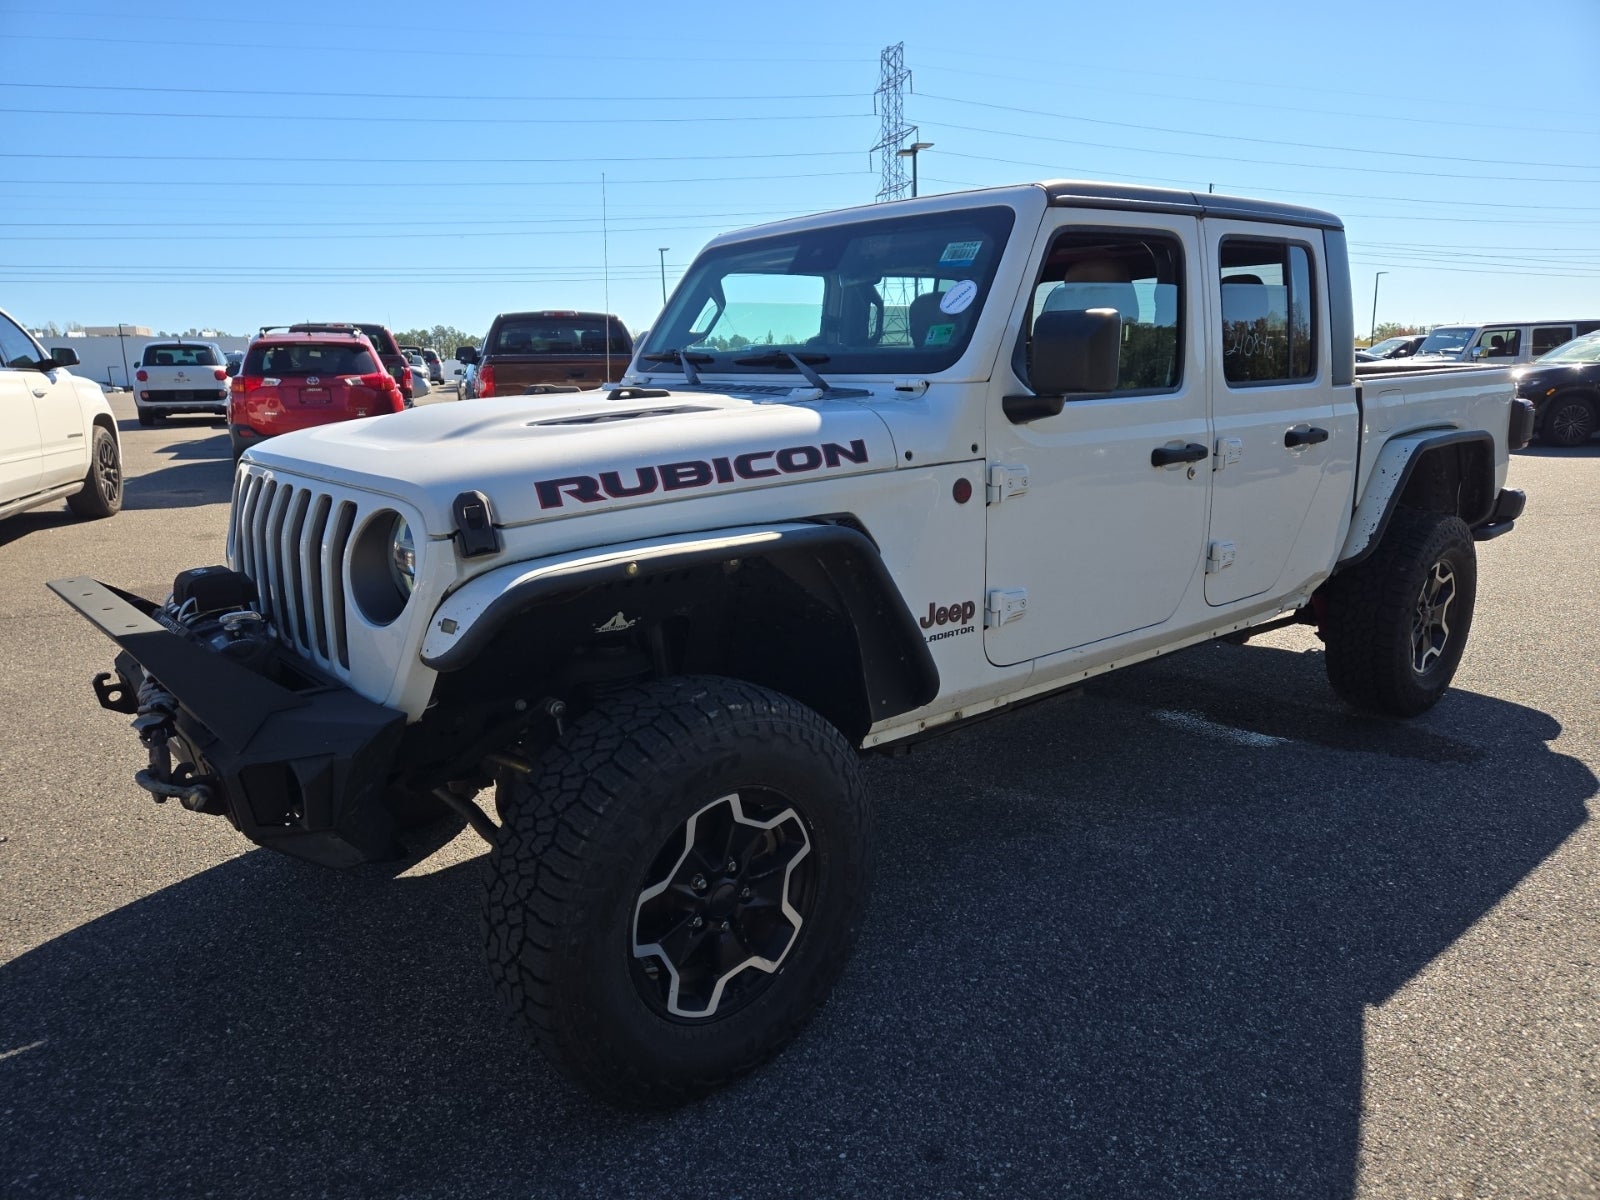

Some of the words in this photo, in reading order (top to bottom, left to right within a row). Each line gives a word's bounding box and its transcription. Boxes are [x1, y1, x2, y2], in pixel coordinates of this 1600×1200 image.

[534, 439, 869, 509] RUBICON
[920, 601, 975, 629] Jeep
[923, 626, 975, 643] LADIATOR
